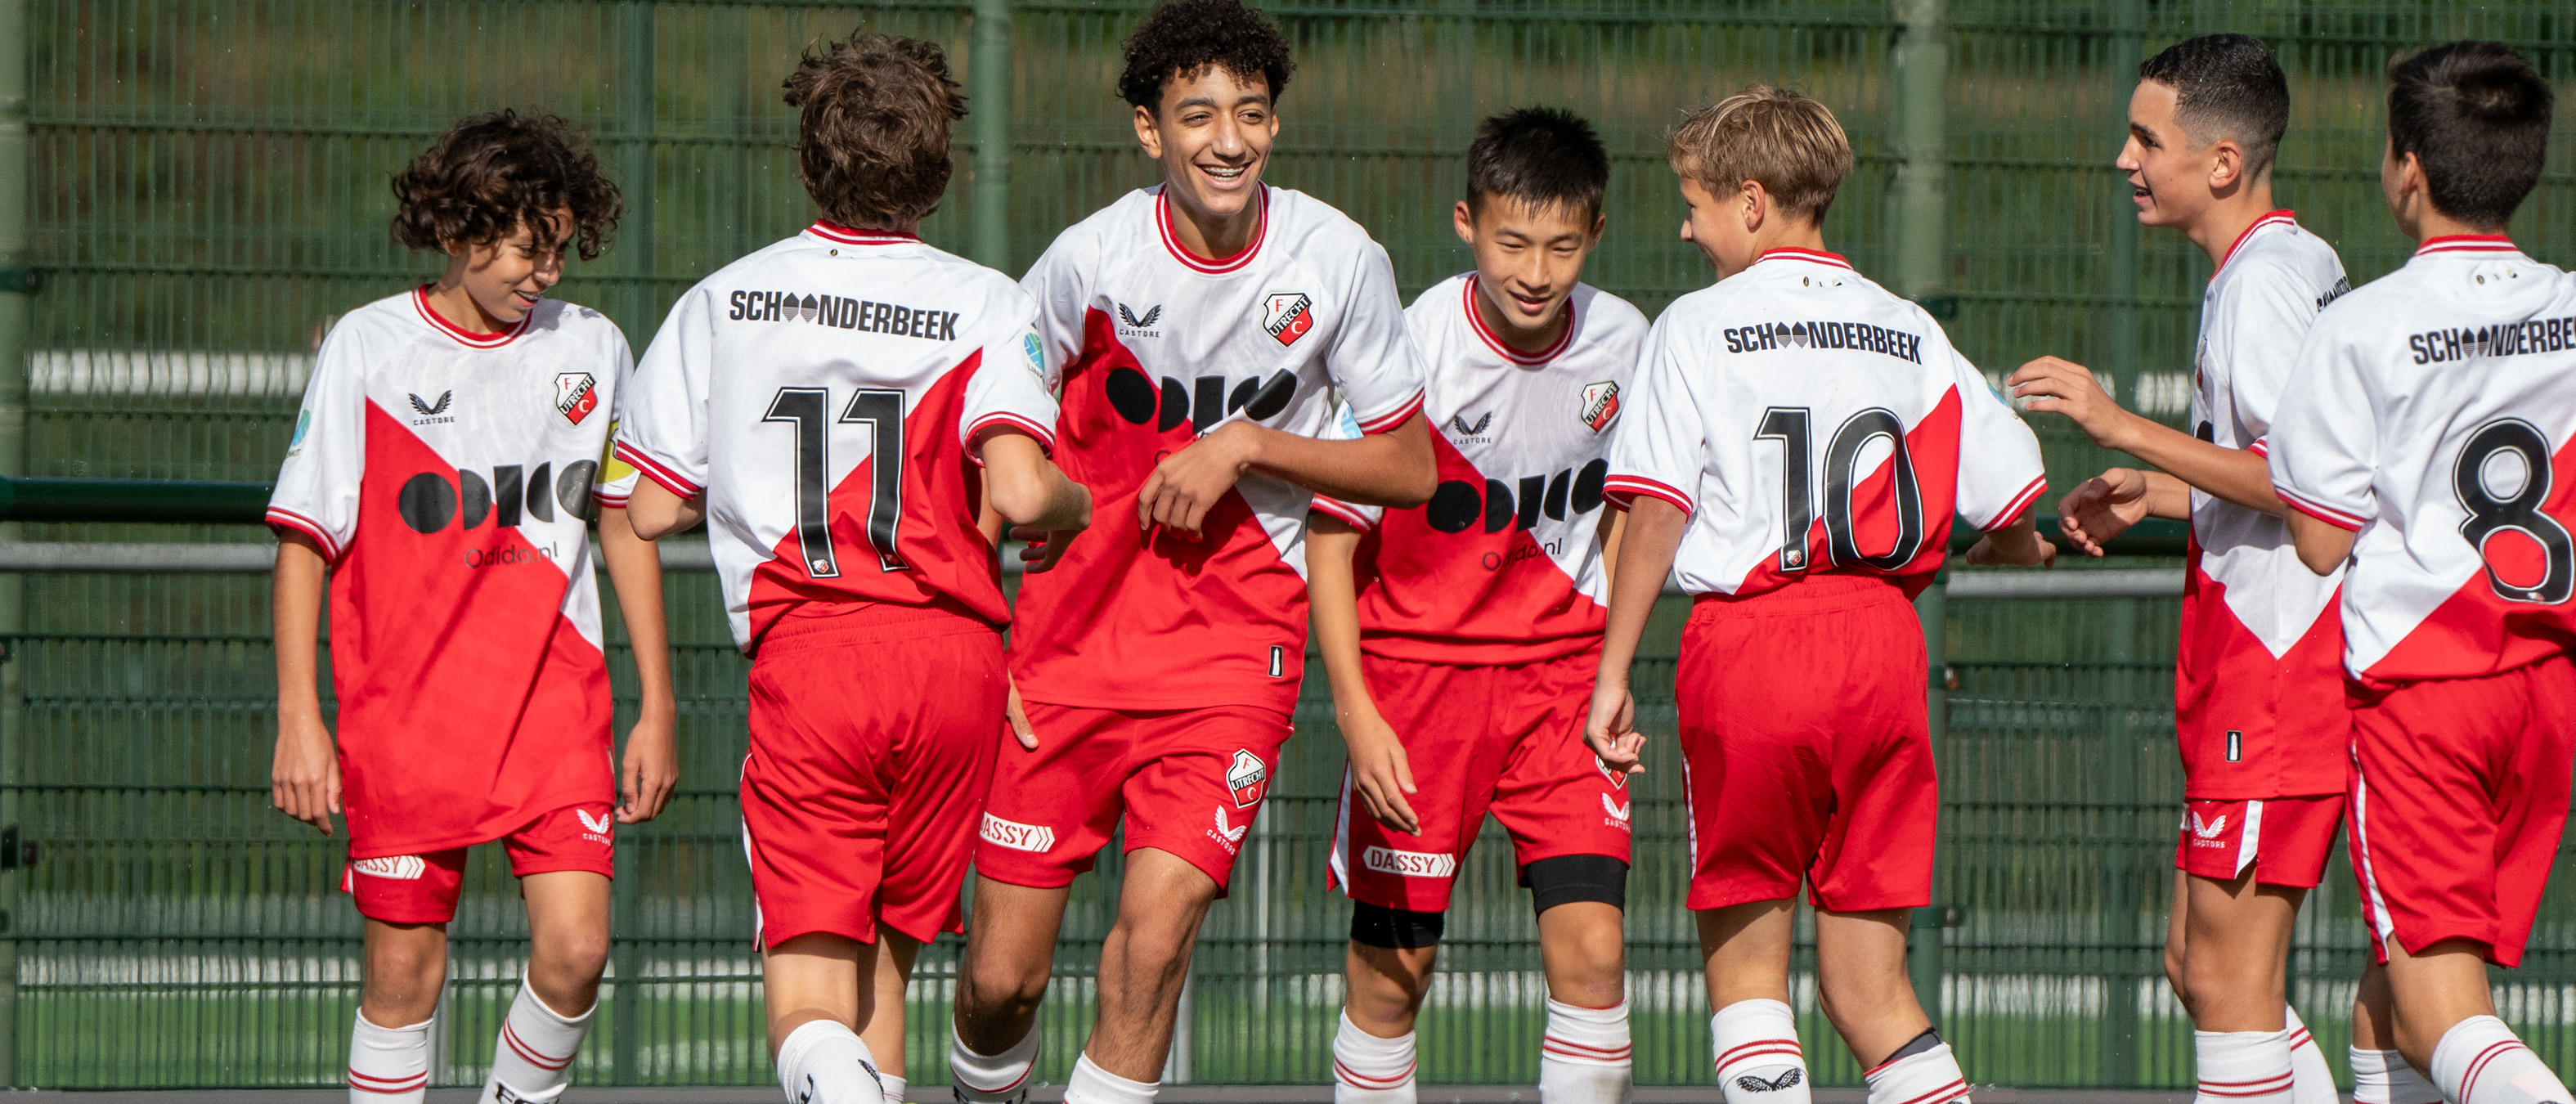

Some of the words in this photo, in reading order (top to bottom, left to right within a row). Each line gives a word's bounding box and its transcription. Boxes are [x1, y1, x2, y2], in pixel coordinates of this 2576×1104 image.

[1268, 295, 1309, 337] UTRECHT
[1275, 298, 1283, 312] F
[1119, 329, 1160, 338] CASTORE
[1291, 321, 1303, 334] C
[2409, 316, 2576, 365] SCHOONDERBE
[559, 375, 595, 415] UTRECHT
[564, 378, 572, 390] F
[1589, 388, 1596, 402] F
[578, 399, 590, 414] C
[1585, 383, 1618, 425] UTRECHT
[413, 416, 456, 426] CASTORE
[1453, 437, 1492, 445] CASTORE
[761, 386, 913, 580] 11
[1752, 406, 1925, 572] 10
[2451, 416, 2576, 606] 8
[464, 541, 559, 568] Odido.nl
[1482, 537, 1563, 571] Odido.nl
[1242, 757, 1252, 770] F
[1230, 769, 1265, 791] UTRECHT
[981, 817, 1033, 846] ASSY
[1206, 828, 1236, 855] CASTORE
[1371, 849, 1436, 874] DASSY
